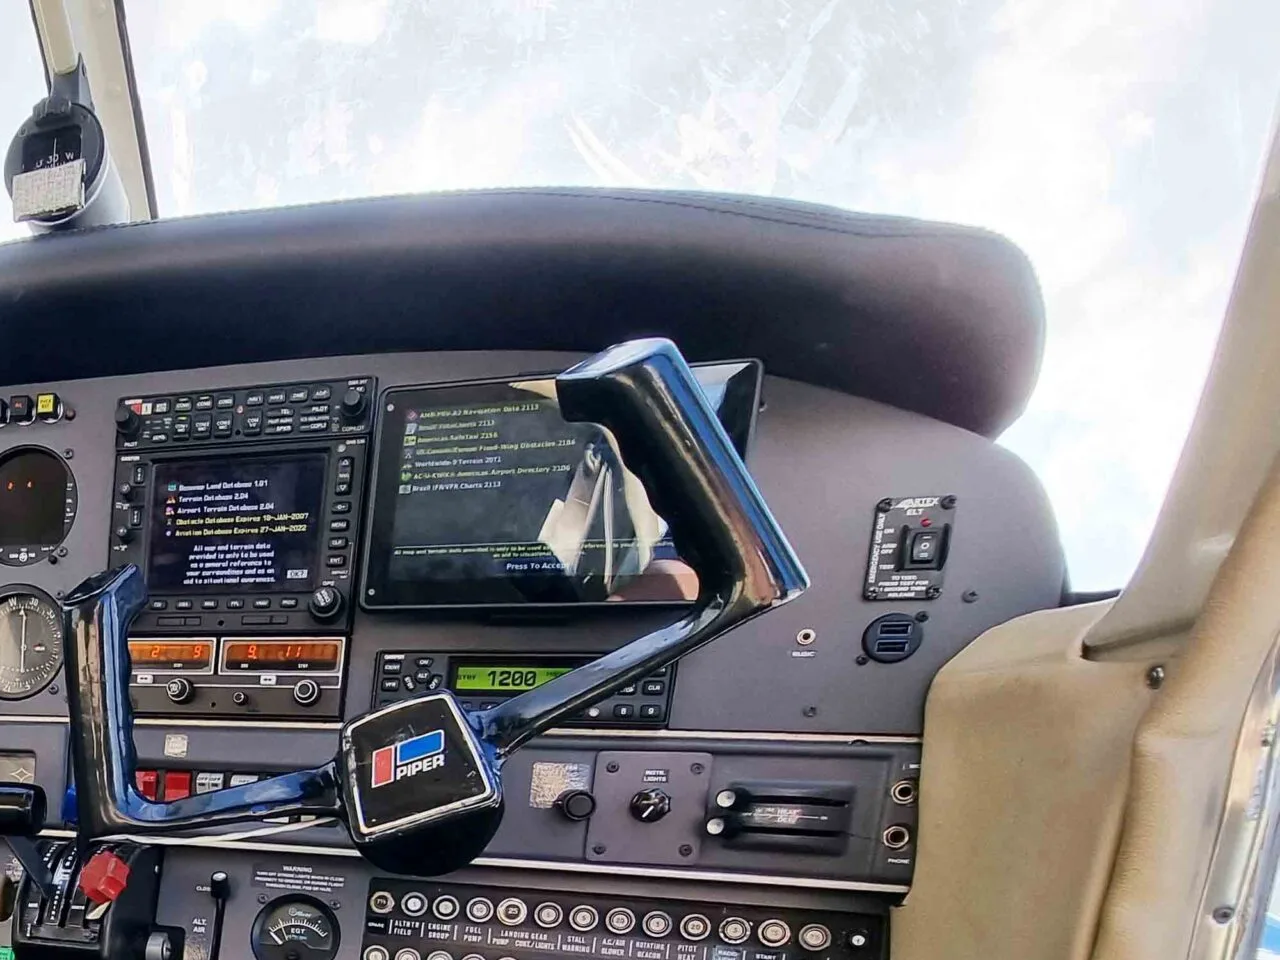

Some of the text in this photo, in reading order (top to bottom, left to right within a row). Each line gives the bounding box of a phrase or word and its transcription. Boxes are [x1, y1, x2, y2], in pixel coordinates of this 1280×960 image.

[65, 152, 74, 160] W
[906, 508, 924, 516] ELT
[487, 670, 537, 686] 1200
[396, 754, 444, 780] PIPER
[282, 865, 312, 873] WARNING
[428, 922, 451, 931] ENGINE
[465, 926, 481, 934] FUEL
[394, 927, 411, 936] FIELD
[428, 931, 450, 940] GROUP
[501, 930, 548, 940] LANDING GEAR
[463, 934, 482, 942] PUMP
[492, 938, 509, 946] PUMP
[567, 936, 585, 944] STALL
[562, 945, 590, 953] WARNING
[635, 941, 665, 950] ROTATING
[677, 944, 697, 952] PITOT
[601, 947, 625, 956] BLOWER
[636, 951, 661, 960] BEACON
